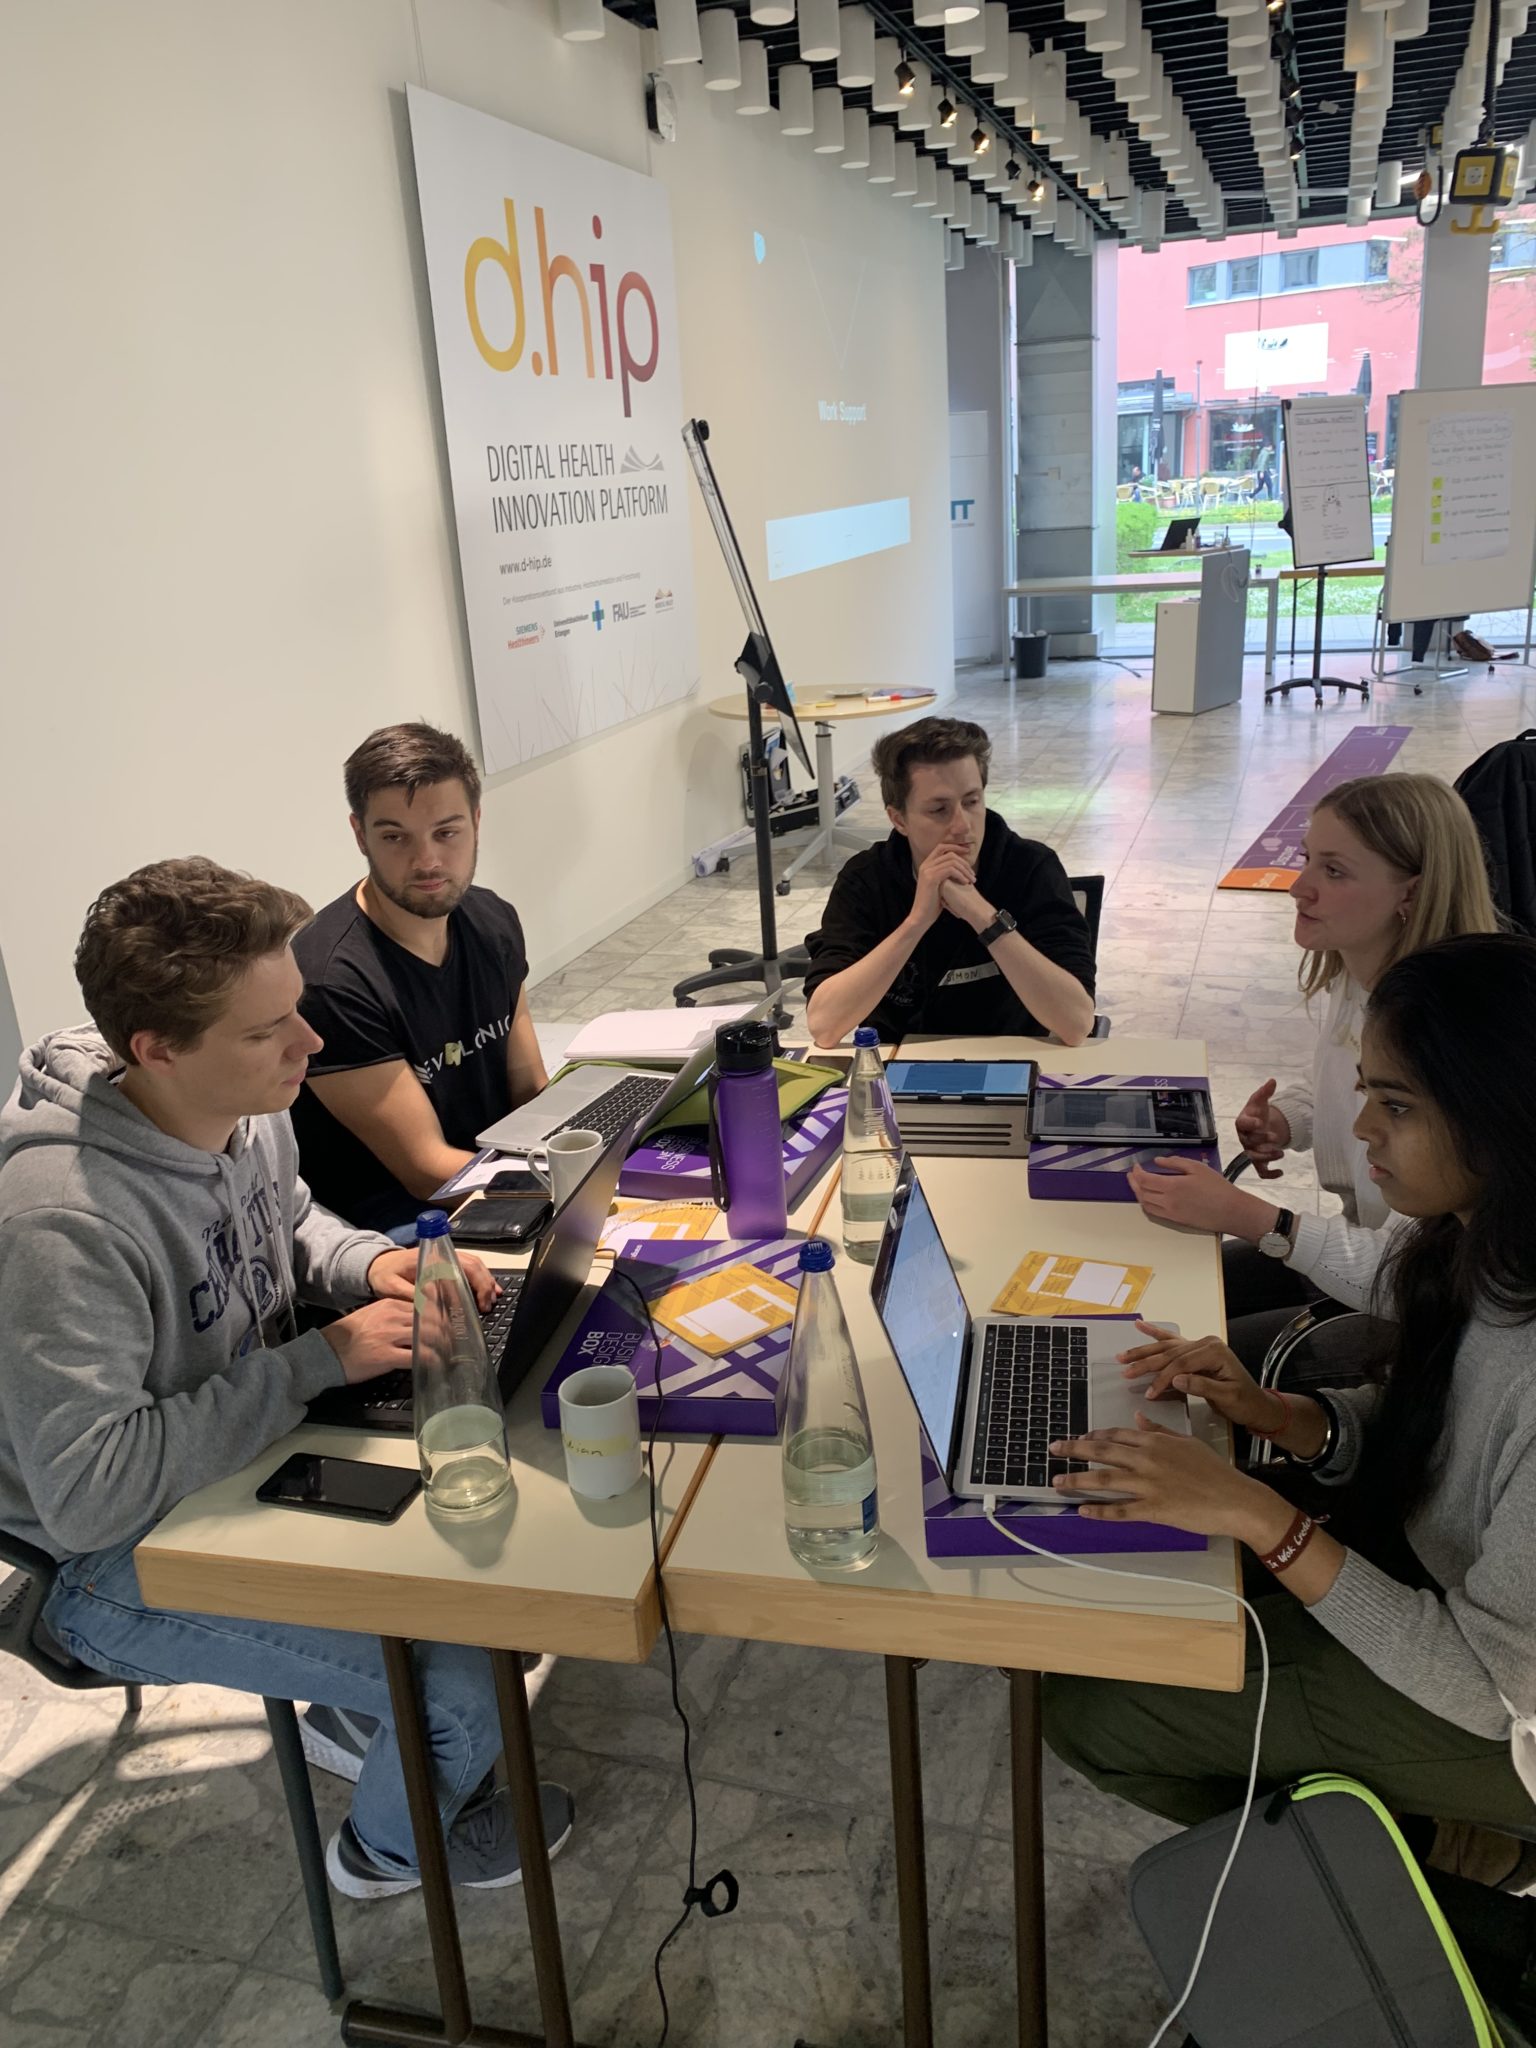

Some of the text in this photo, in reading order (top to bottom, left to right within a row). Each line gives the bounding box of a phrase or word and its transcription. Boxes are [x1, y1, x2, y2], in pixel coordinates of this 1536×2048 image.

[464, 197, 660, 418] d.hip
[487, 443, 616, 483] DIGITAL HEALTH
[492, 484, 669, 534] INNOVATION PLATFORM
[499, 556, 552, 575] www.d-hip.de
[515, 622, 538, 635] SIEMENS
[612, 601, 630, 623] FAU
[577, 1331, 605, 1355] BOX
[592, 1332, 622, 1366] DESIG
[612, 1333, 642, 1366] BUSIN
